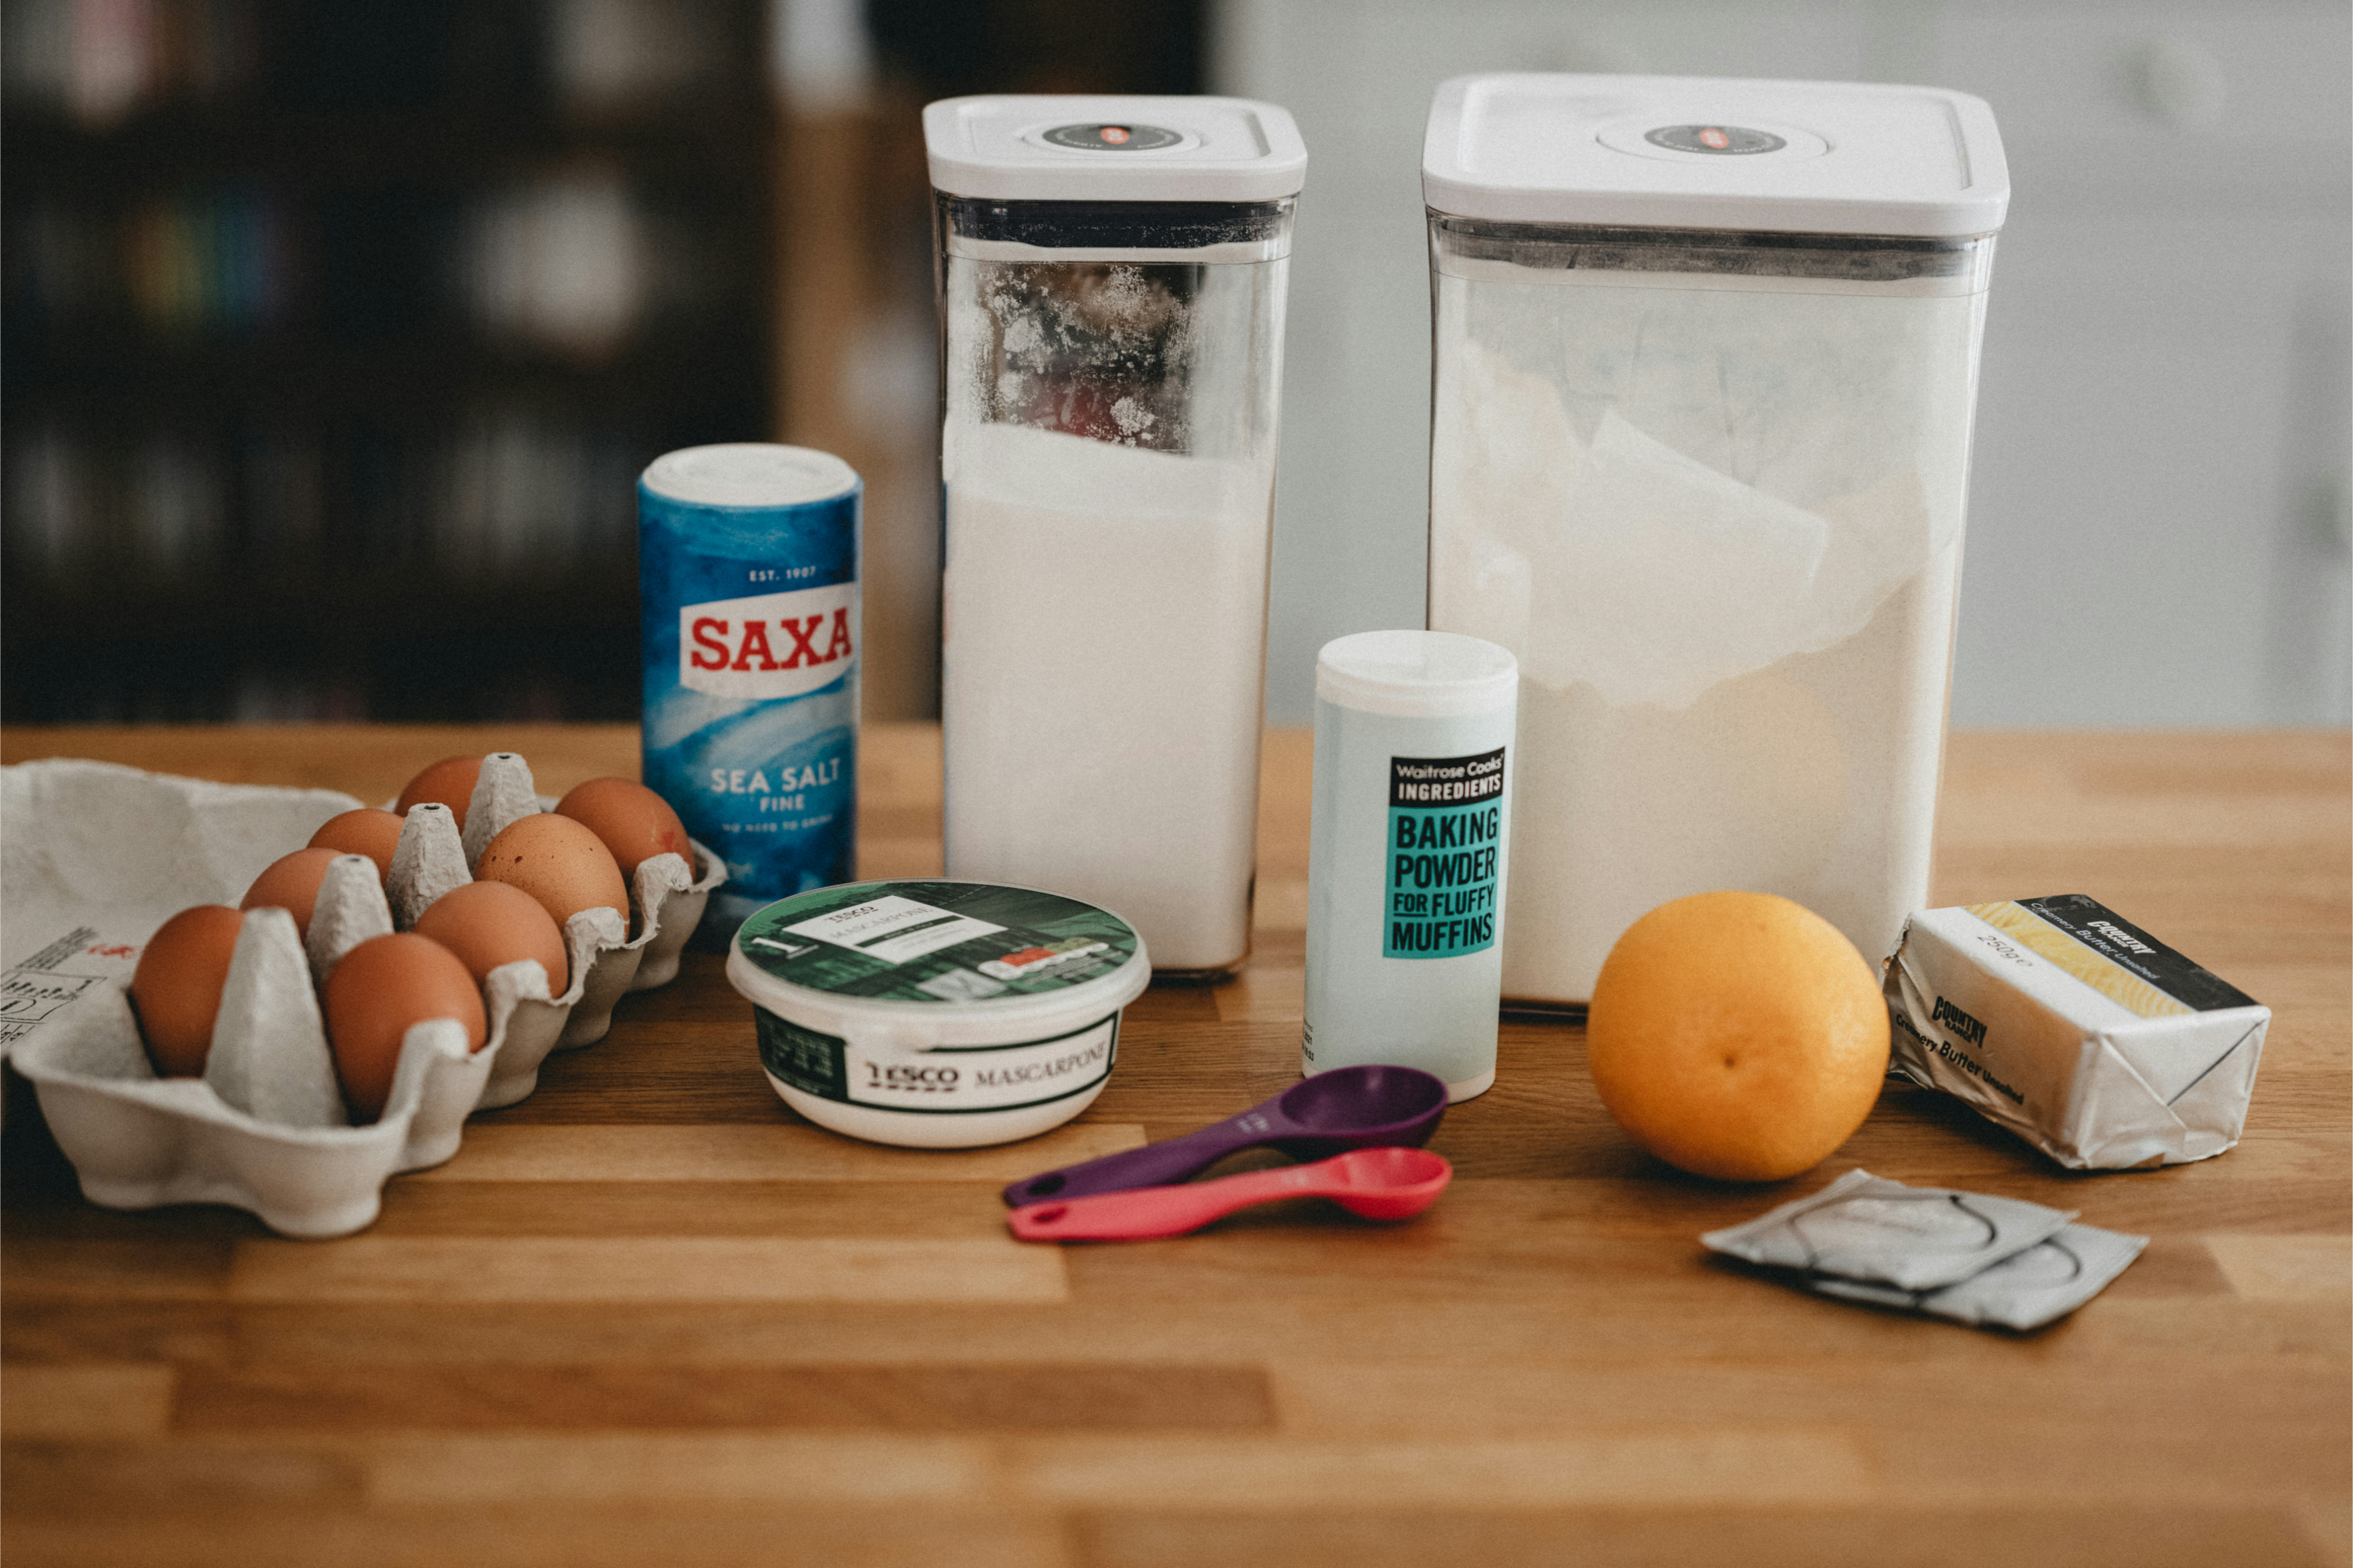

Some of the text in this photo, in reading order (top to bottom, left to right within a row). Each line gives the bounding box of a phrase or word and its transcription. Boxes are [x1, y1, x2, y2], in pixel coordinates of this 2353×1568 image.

[749, 566, 816, 582] EST. 1907
[691, 606, 852, 671] SAXA
[711, 758, 840, 793] SEA SALT
[1396, 764, 1465, 779] Waitrose
[1398, 773, 1501, 801] INGREDIENTS
[760, 794, 805, 812] FINE
[1396, 807, 1498, 849] BAKING
[1394, 846, 1496, 888] POWDER
[1393, 882, 1494, 917] FOR FLUFFY
[1392, 912, 1492, 951] MUFFINS
[2031, 903, 2077, 930] Creamery
[2076, 930, 2118, 953] Butter
[2087, 921, 2157, 954] COUNTRY
[1976, 935, 2020, 959] 250g
[1932, 996, 1988, 1048] COUNTRY
[1939, 1040, 1981, 1075] Butter
